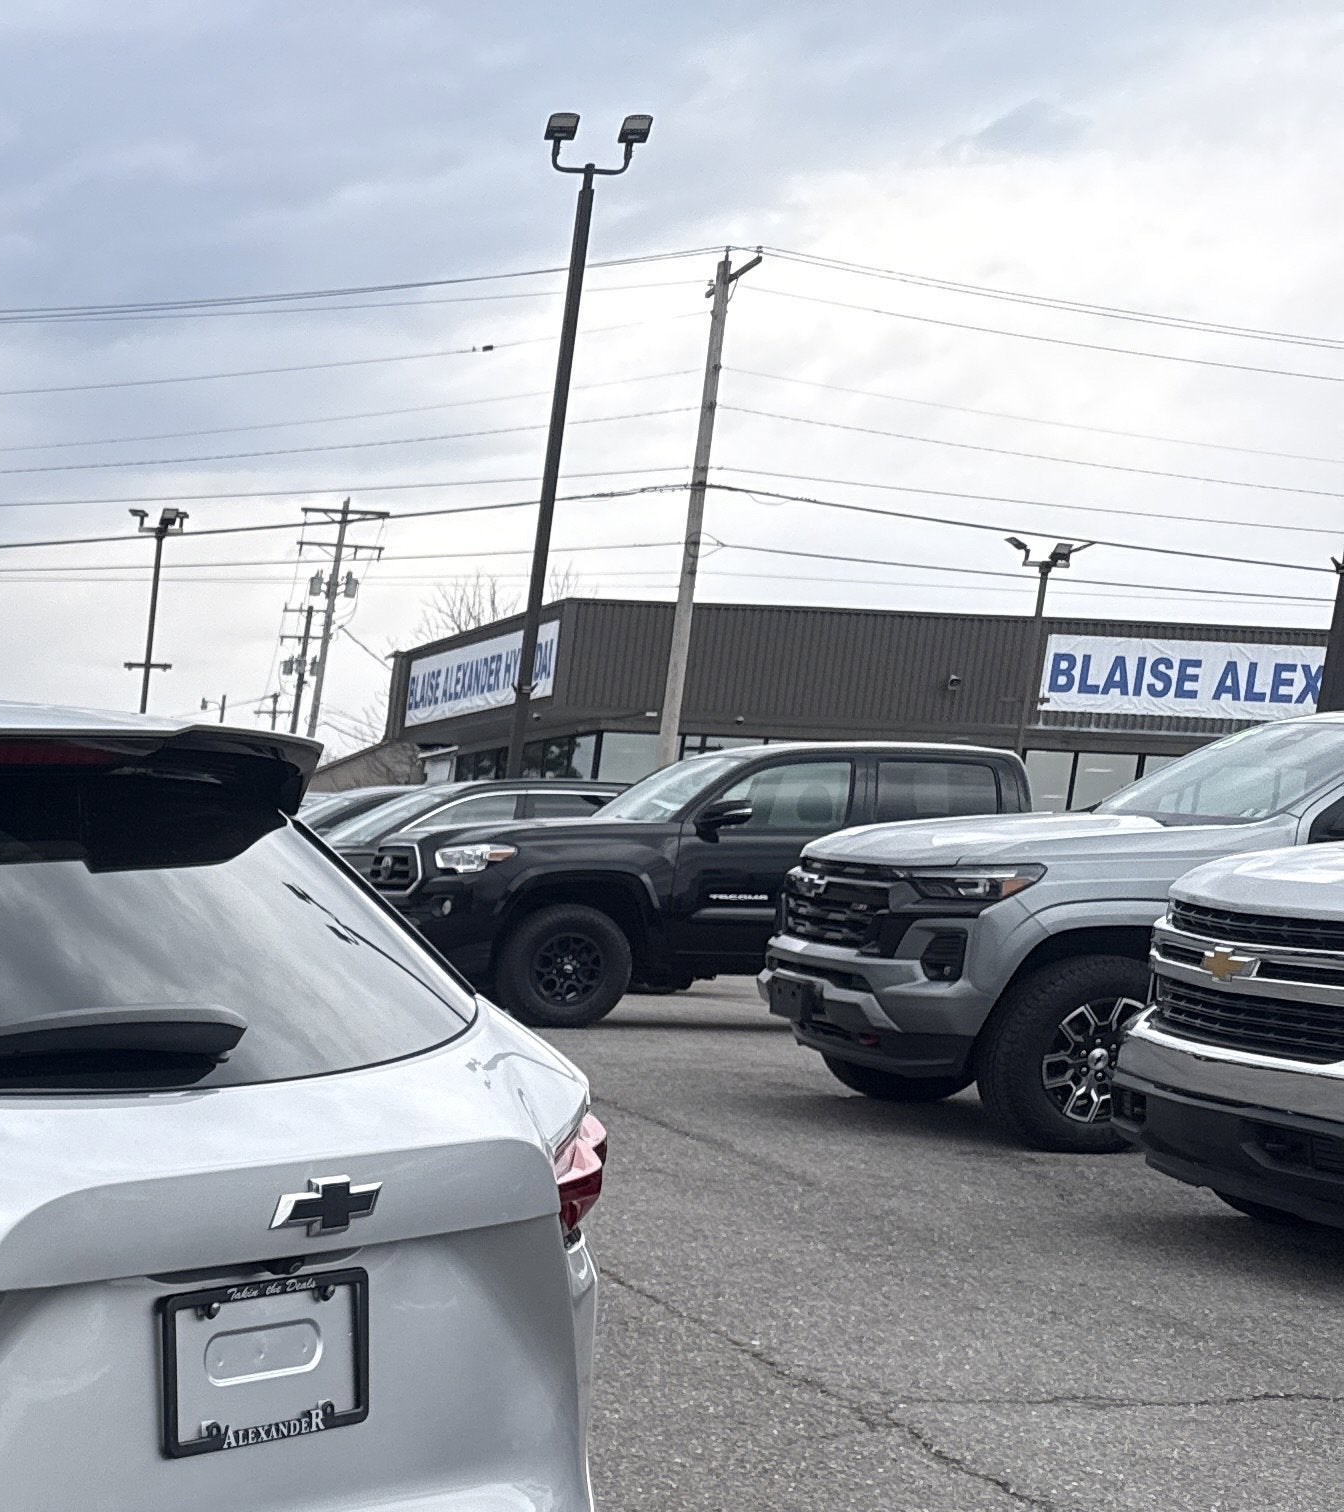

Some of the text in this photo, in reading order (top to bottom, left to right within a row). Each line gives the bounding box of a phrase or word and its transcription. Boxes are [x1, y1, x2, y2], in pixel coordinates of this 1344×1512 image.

[408, 639, 554, 711] BLAISE ALEXANDER HYDAI
[1048, 652, 1203, 700] BLAISE
[265, 1283, 283, 1295] the
[285, 1276, 317, 1293] Deals
[222, 1409, 326, 1449] ALEXANDER
